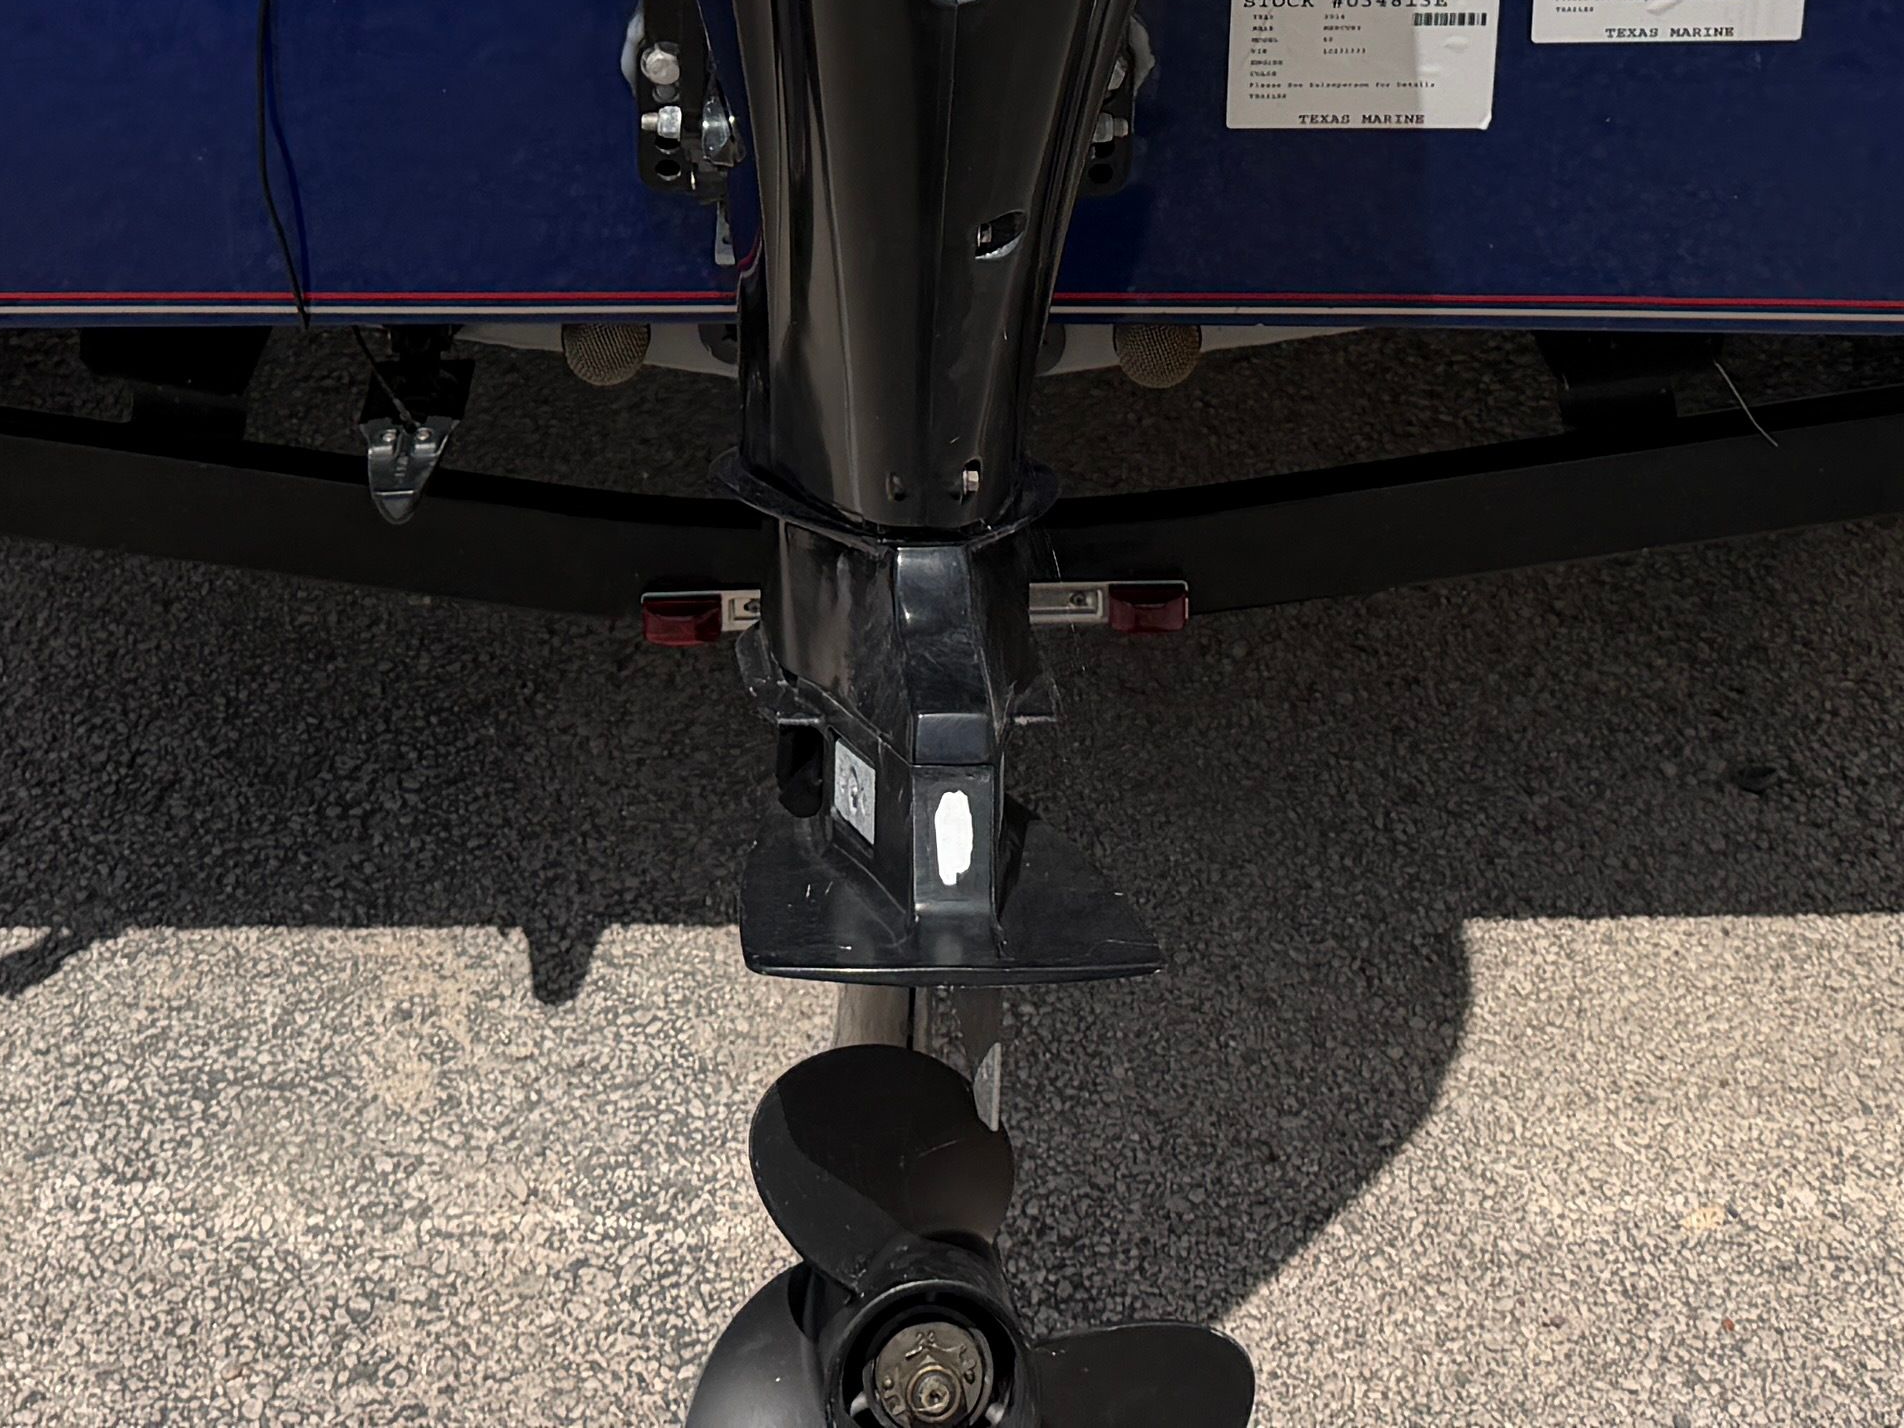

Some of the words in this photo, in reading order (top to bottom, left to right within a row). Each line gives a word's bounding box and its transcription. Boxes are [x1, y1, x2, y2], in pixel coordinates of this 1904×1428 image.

[1604, 27, 1659, 39] TEXAS
[1669, 27, 1735, 38] MARINE
[1298, 114, 1351, 125] TEXAS
[1361, 114, 1425, 125] MARINE
